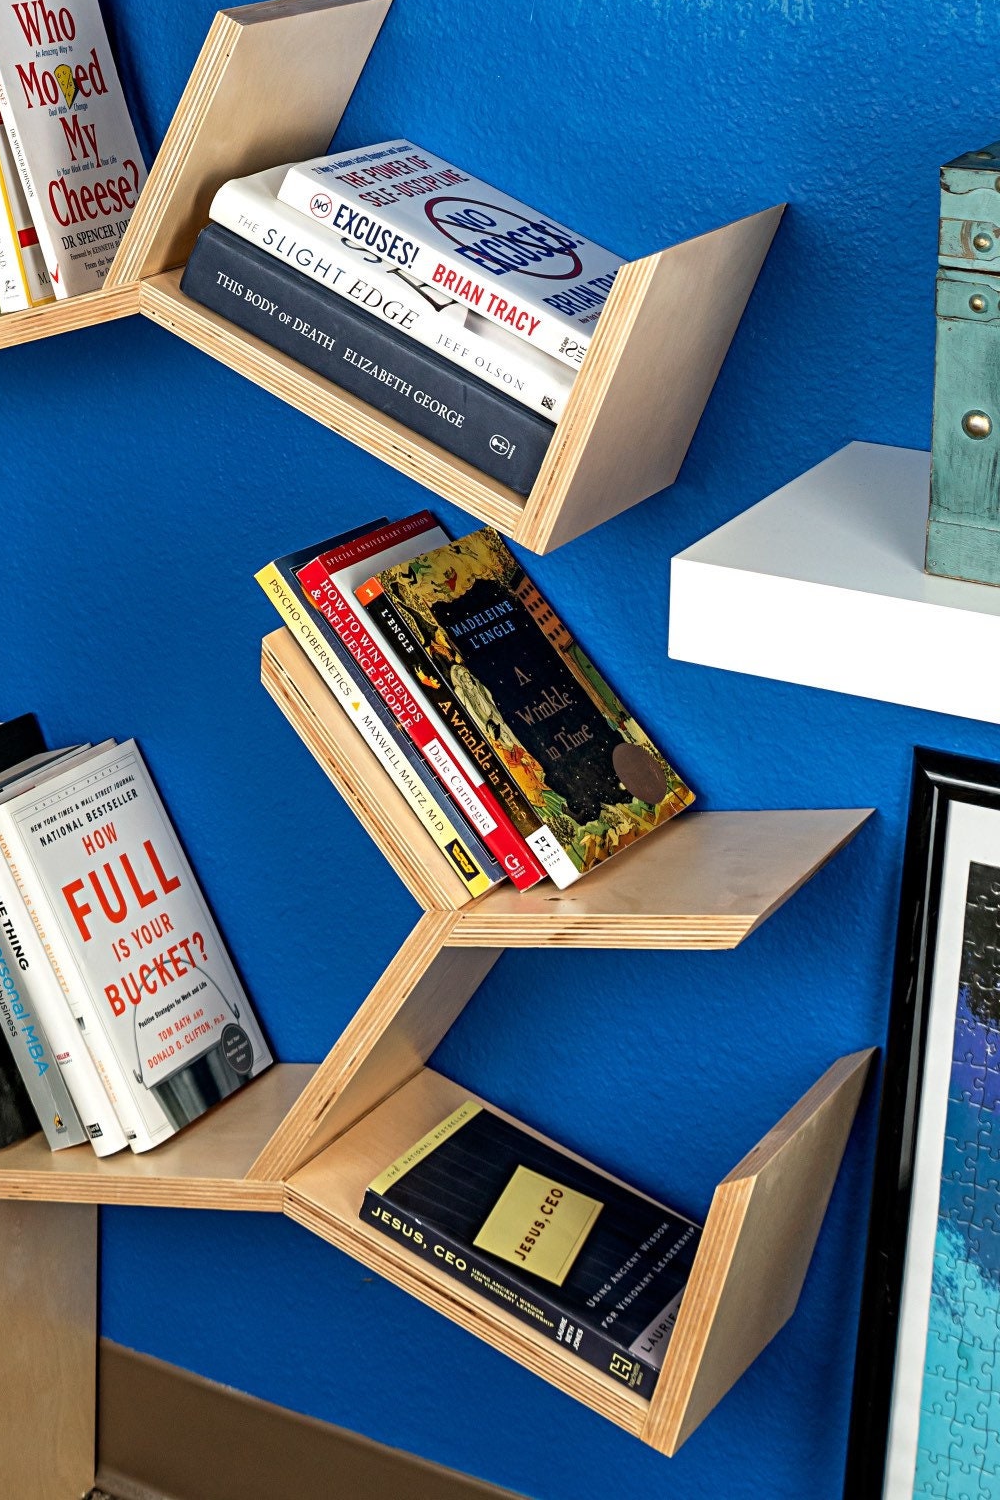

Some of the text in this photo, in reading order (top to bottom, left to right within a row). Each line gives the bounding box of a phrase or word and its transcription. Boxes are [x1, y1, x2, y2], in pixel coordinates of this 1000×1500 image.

[59, 114, 101, 168] My
[48, 159, 140, 227] Cheese?
[446, 208, 497, 232] NO
[313, 199, 542, 336] NO EXCUSES! BRIAN TRACY
[453, 219, 586, 276] EXCUSES!
[238, 214, 526, 392] THE SLIGHT EDGE JEFF OLSON
[216, 271, 465, 429] THIS BODY OF DEATH ELIZABETH GEORGE
[269, 578, 352, 696] PSYCHO-CYBERNETICS
[381, 608, 415, 654] L'ENGLE
[450, 600, 514, 637] MADELEINE
[468, 620, 516, 649] L'ENGLE
[311, 589, 413, 730] & INFLUENCE PEOPLE
[320, 579, 424, 723] HOW TO WIN FRIENDS
[514, 666, 532, 686] A
[515, 685, 574, 727] Wrinkle
[545, 721, 595, 762] in Time
[428, 744, 451, 774] Dale
[449, 774, 491, 831] Carnegie
[39, 788, 139, 847] NATIONAL BESTSELLER
[81, 821, 118, 856] HOW
[61, 839, 182, 942] FULL
[3, 919, 30, 971] THING
[112, 912, 175, 962] IS YOUR
[104, 932, 209, 1018] BUCKET?
[138, 1014, 155, 1029] Positive
[154, 1003, 176, 1020] Strategies
[181, 991, 191, 1003] Work
[191, 986, 200, 996] and
[199, 981, 208, 991] Life
[22, 1025, 50, 1077] MBA
[371, 1207, 468, 1271] JESUS, CEO
